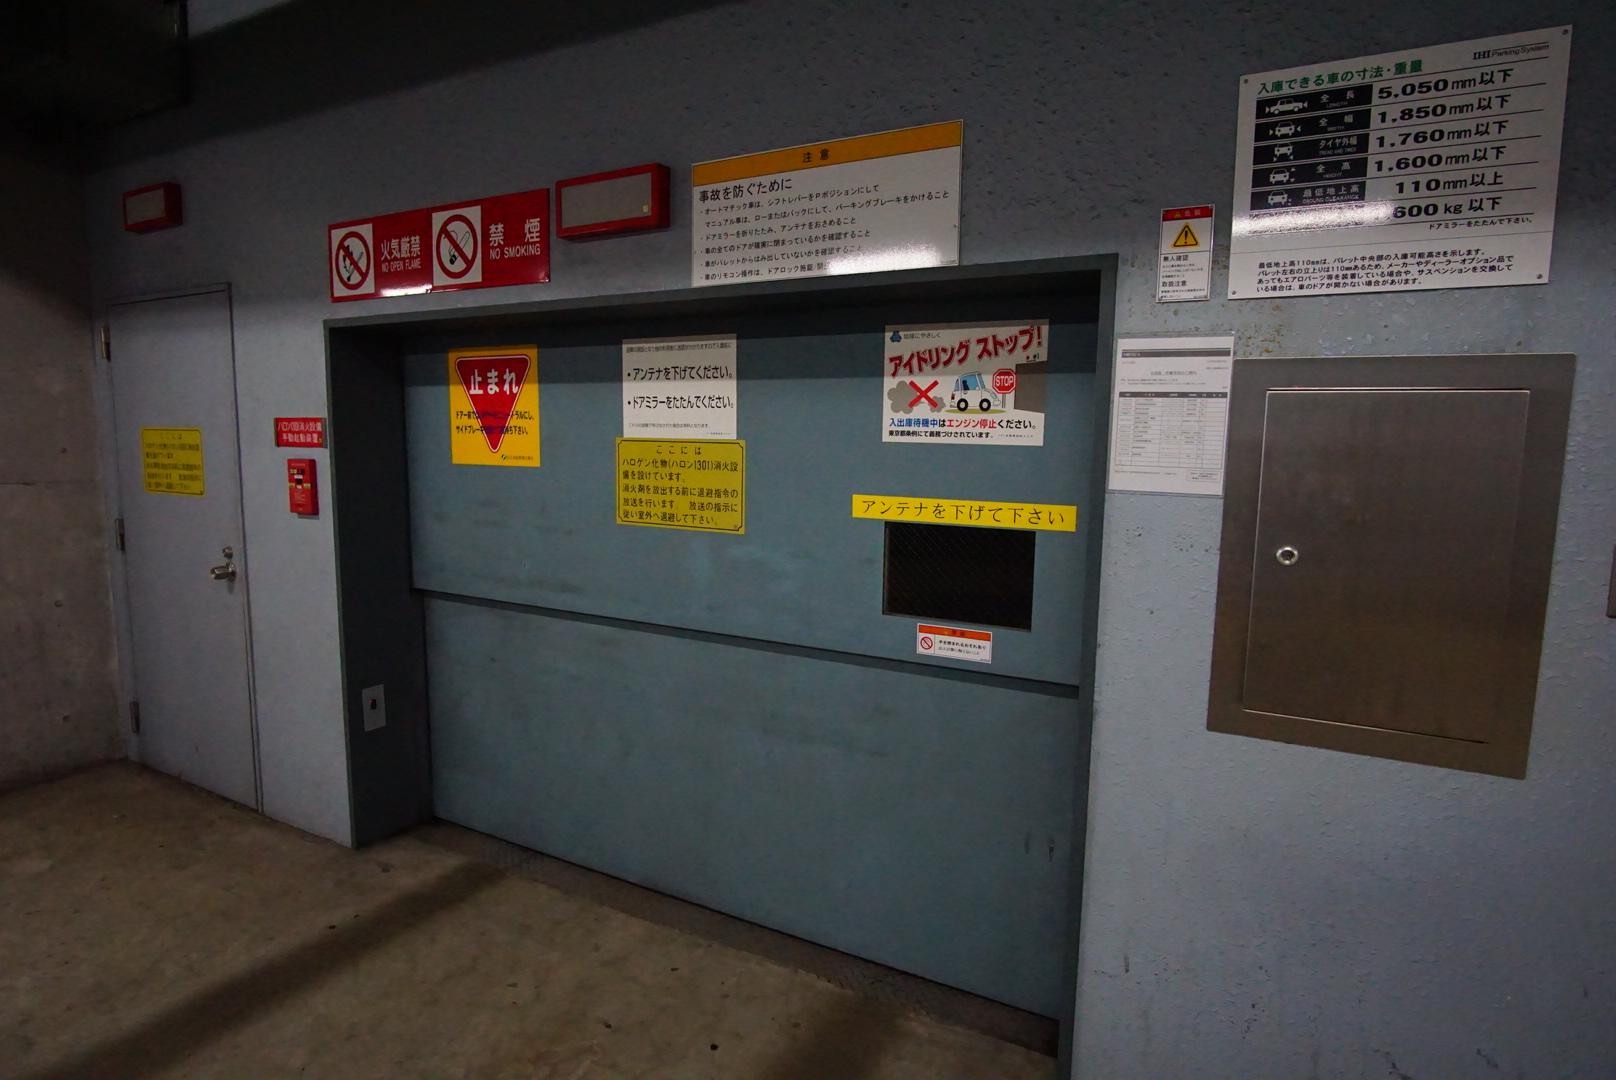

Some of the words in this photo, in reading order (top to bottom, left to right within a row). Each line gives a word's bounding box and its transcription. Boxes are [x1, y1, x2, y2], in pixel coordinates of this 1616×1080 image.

[1472, 50, 1491, 60] IHI
[699, 178, 793, 203] 事故を防ぐために
[1468, 196, 1503, 212] 以下
[488, 217, 541, 247] 禁煙
[380, 235, 421, 261] 火気厳禁
[489, 248, 501, 260] NO
[503, 243, 541, 258] SMOKING
[381, 262, 389, 273] NO
[390, 260, 404, 272] OPEN
[405, 257, 422, 270] FLAME
[889, 339, 970, 378] アイドリング
[633, 365, 732, 381] アンテナを下げてください。
[995, 375, 1014, 387] STOP
[469, 367, 519, 396] 止まれ
[633, 394, 734, 409] ドアミラーをたたんでください。
[889, 418, 1037, 430] 入出庫待機中はエンジン停止ください。
[888, 429, 993, 439] 東京都条例にて義務づけされています。
[656, 445, 702, 455] ここには
[623, 484, 739, 499] 消火剤を放出する前に退避指令の
[622, 510, 718, 525] 従い室外へ退避して下さい。
[861, 499, 1065, 526] アンテナを下げて下さい
